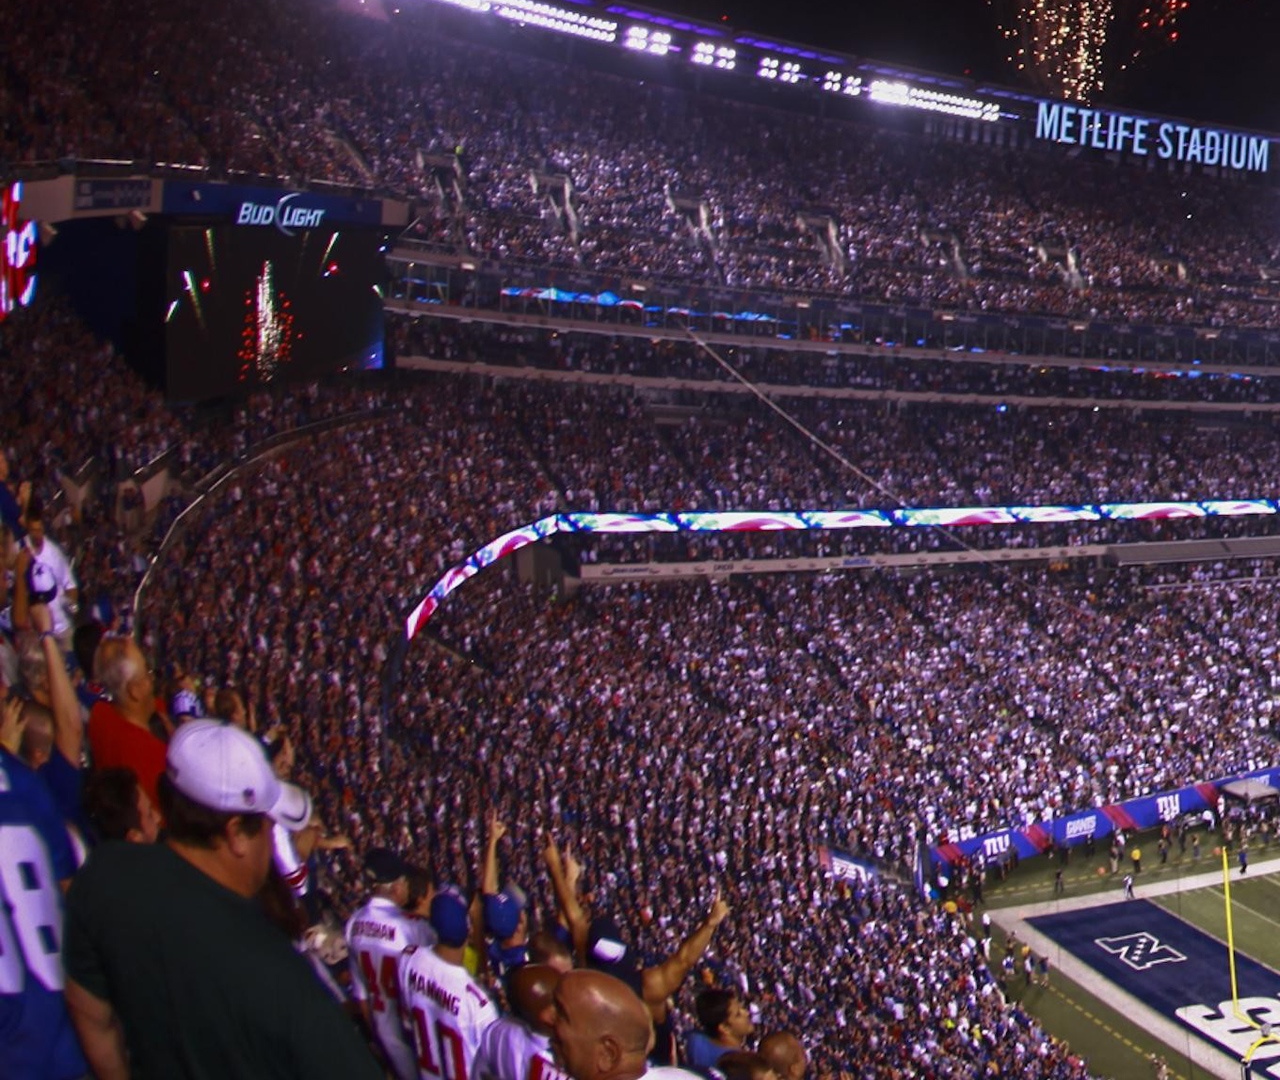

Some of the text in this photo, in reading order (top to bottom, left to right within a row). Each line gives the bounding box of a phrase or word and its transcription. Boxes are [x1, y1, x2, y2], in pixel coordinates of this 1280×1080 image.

[1035, 101, 1270, 173] METLIFE STADIUM
[237, 202, 326, 228] BUD LIGHT
[408, 967, 461, 1017] MANNING
